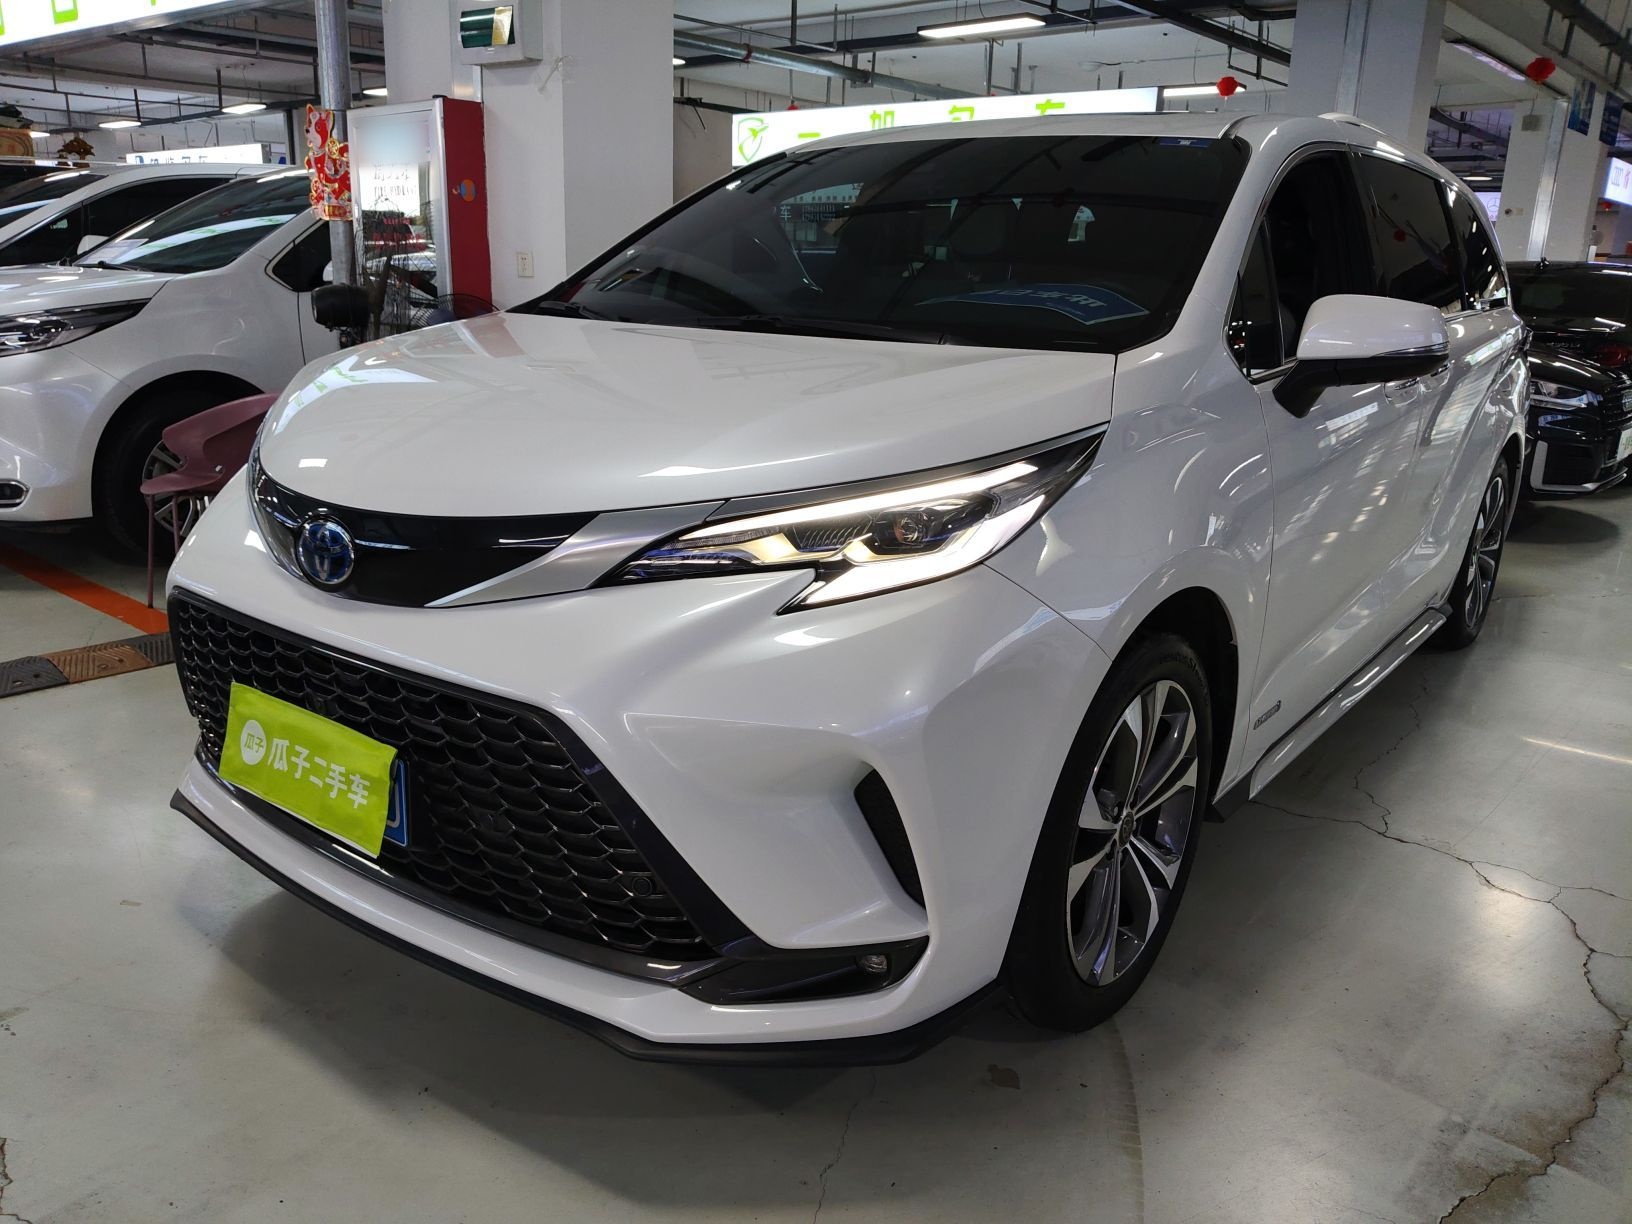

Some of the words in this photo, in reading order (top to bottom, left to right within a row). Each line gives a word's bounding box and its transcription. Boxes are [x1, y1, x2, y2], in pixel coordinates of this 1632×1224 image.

[267, 738, 370, 809] 瓜子二手车
